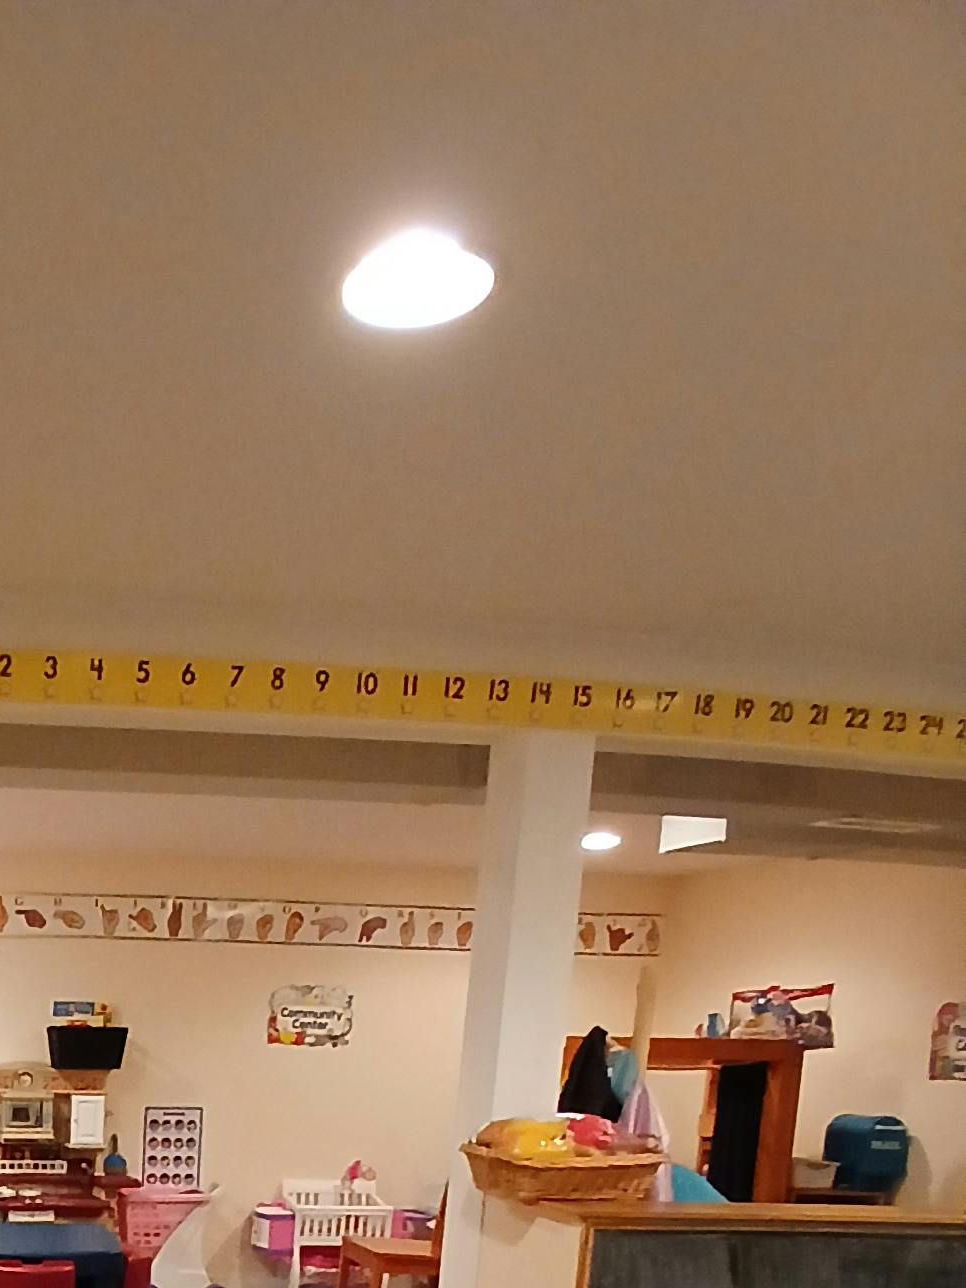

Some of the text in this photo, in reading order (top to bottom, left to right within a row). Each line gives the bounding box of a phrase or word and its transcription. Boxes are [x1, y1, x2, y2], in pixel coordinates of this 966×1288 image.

[43, 655, 59, 680] 3
[89, 657, 104, 681] 4
[135, 659, 151, 684] 5
[181, 662, 197, 686] 6
[229, 665, 245, 688] 7
[270, 667, 286, 691] 8
[315, 669, 330, 692] 9
[356, 672, 379, 695] 10
[402, 673, 419, 697] 11
[443, 676, 467, 700] 12
[488, 679, 510, 702] 13
[530, 681, 552, 705] 14
[573, 685, 593, 708] 15
[615, 687, 636, 710] 16
[656, 691, 678, 712] 17
[693, 693, 715, 716] 18
[734, 697, 755, 719] 19
[769, 700, 794, 723] 20
[809, 703, 829, 725] 21
[845, 706, 870, 729] 22
[882, 710, 907, 732] 23
[920, 714, 944, 735] 24
[280, 1007, 343, 1021] Community
[292, 1019, 329, 1030] Center
